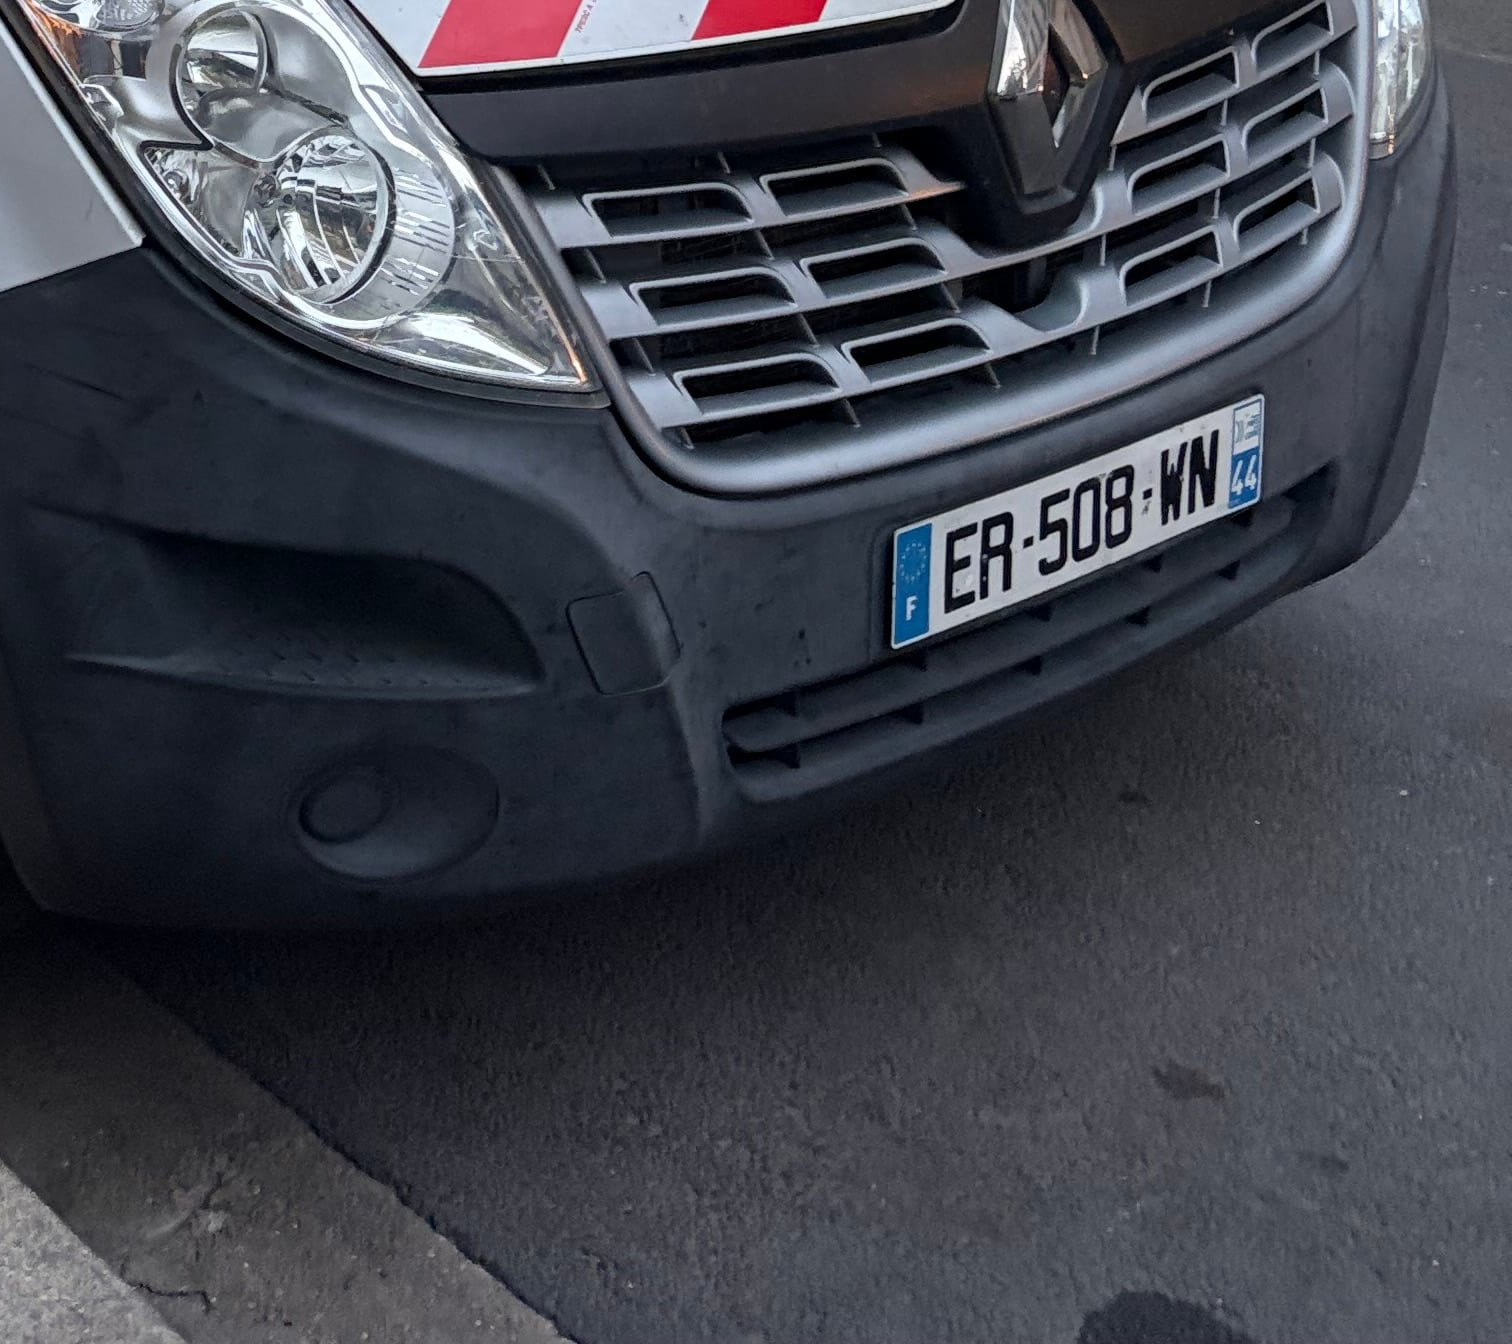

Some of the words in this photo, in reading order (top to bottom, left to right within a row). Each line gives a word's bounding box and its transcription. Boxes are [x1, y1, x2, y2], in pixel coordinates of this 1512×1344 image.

[905, 595, 918, 622] F
[943, 429, 1220, 614] ER-508-WN
[1230, 453, 1258, 497] 44
